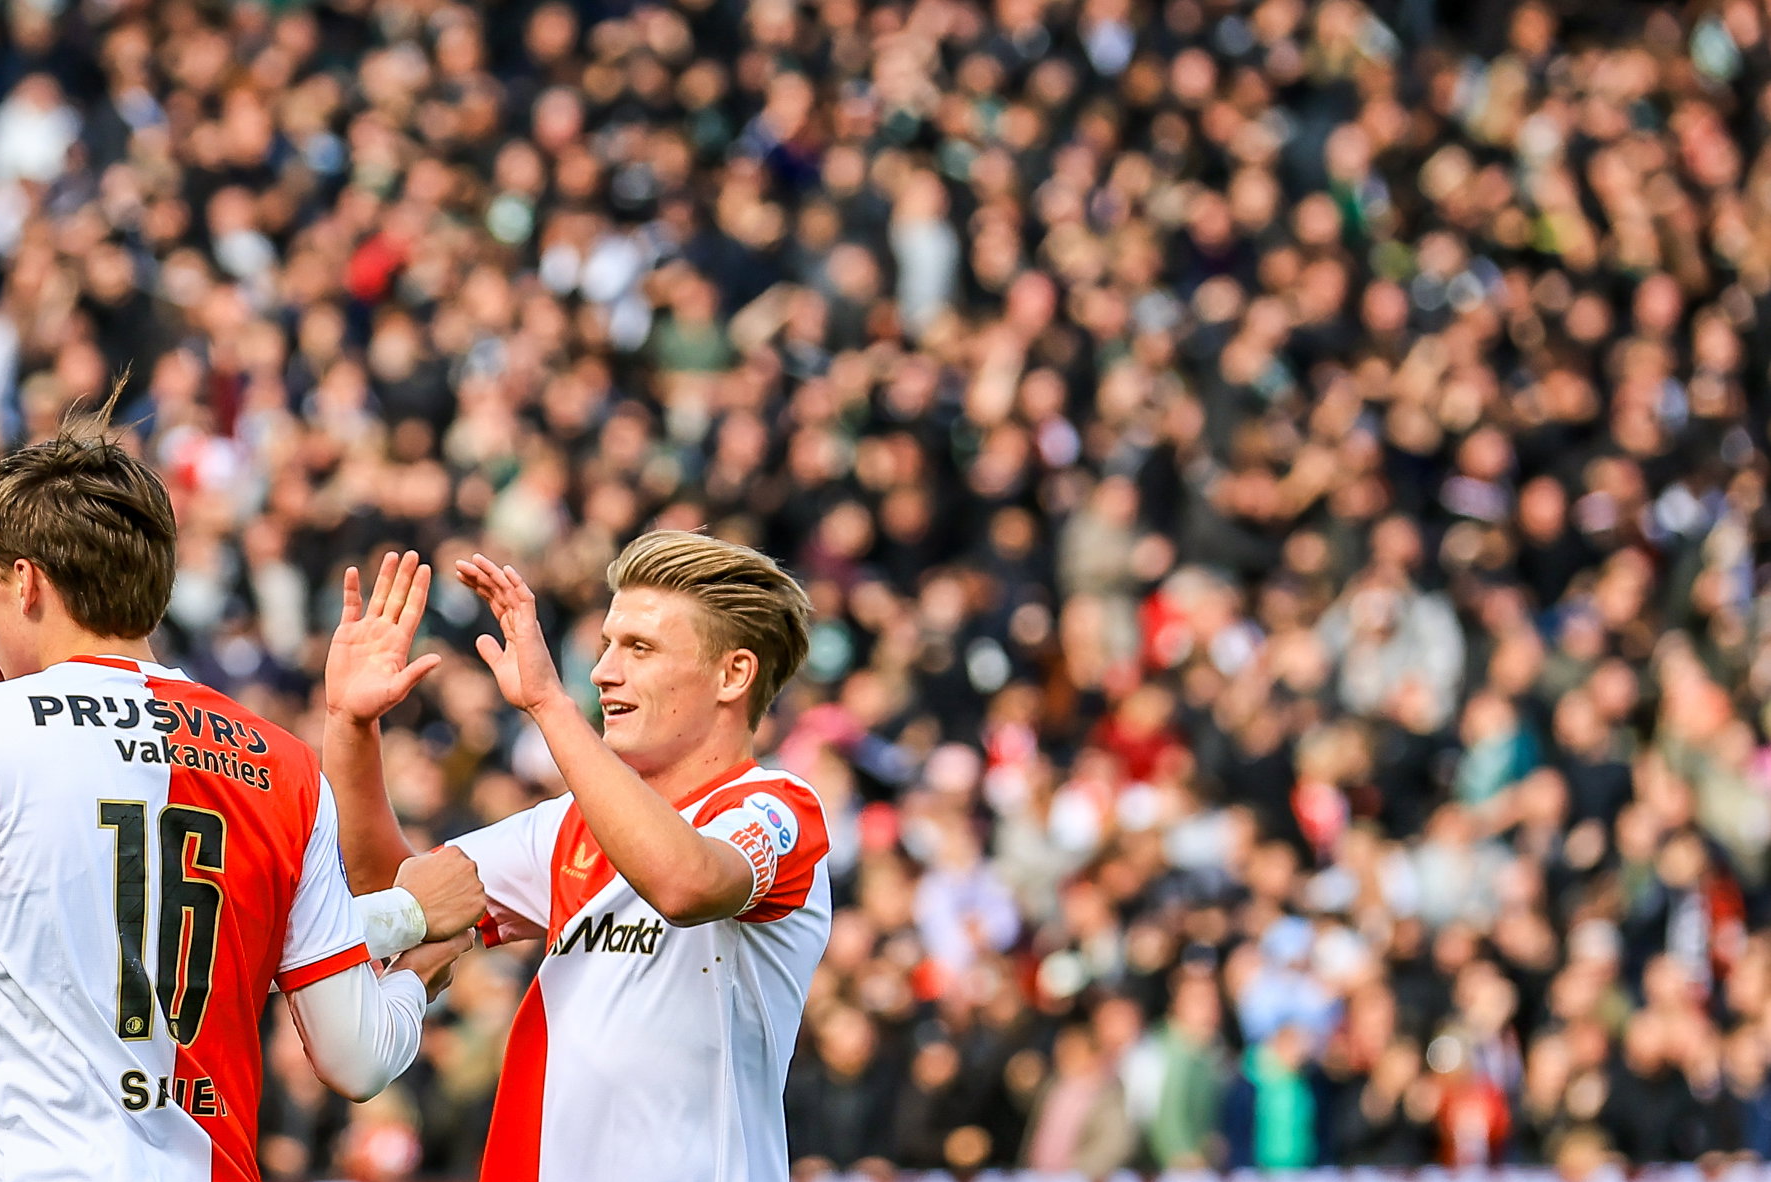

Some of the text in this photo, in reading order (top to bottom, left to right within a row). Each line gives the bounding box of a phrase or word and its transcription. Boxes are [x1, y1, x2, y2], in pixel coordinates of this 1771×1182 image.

[114, 735, 271, 791] vakanties
[97, 799, 227, 1049] 16
[551, 911, 664, 957] Markt
